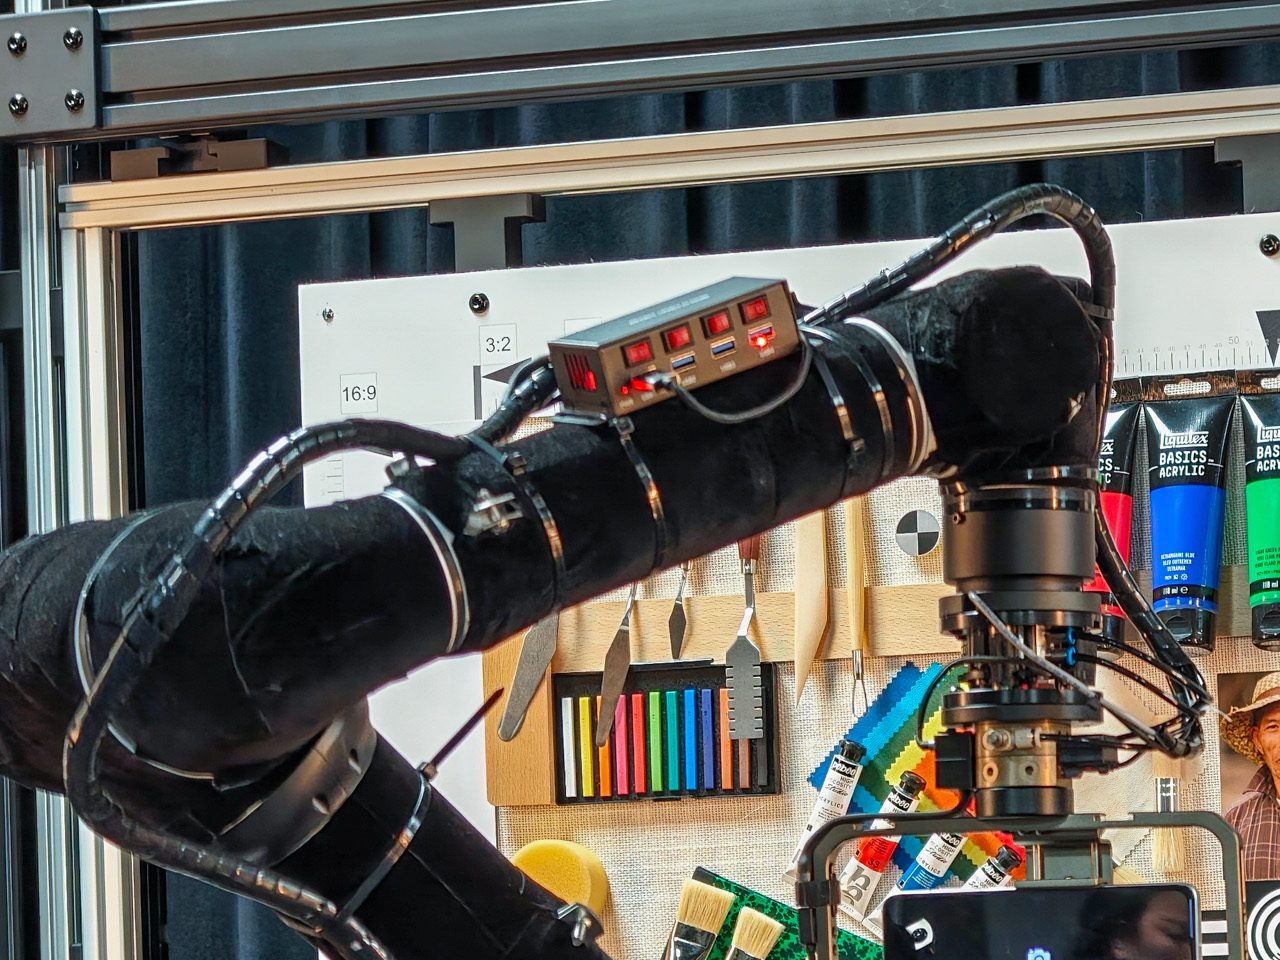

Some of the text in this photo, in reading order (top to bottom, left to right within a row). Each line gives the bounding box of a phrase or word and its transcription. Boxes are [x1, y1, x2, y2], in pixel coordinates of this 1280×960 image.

[485, 337, 512, 353] 3:2
[1228, 336, 1240, 345] 50
[342, 385, 377, 403] 16:9
[1160, 430, 1209, 450] Liquitex
[1160, 450, 1207, 466] BASICS
[1160, 465, 1205, 478] ACRYLIC
